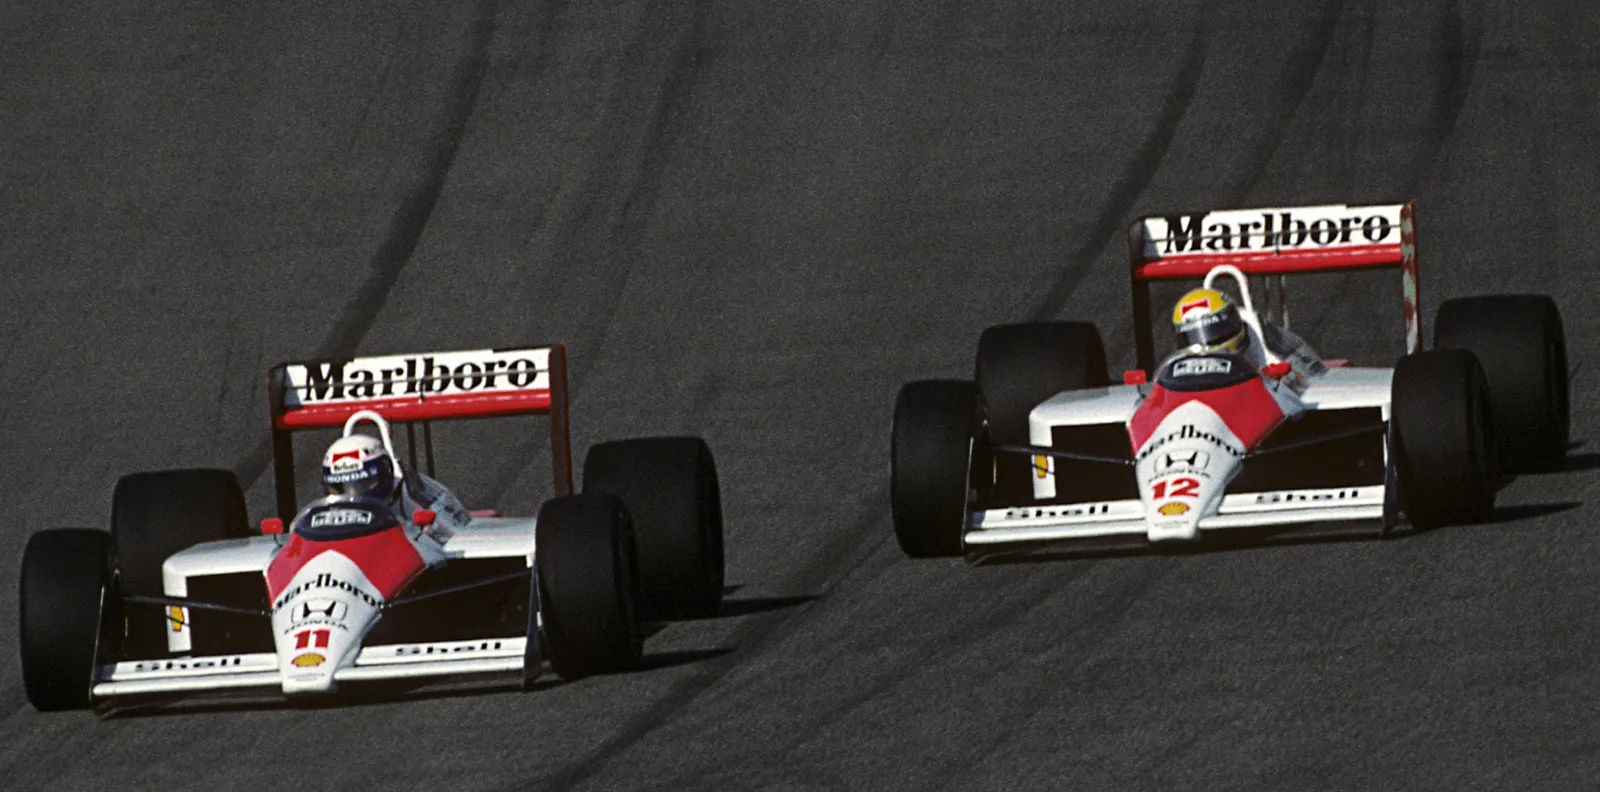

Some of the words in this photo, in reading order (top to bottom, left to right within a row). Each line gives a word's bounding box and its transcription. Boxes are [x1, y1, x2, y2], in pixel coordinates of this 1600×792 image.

[1164, 212, 1391, 253] Marlboro
[305, 357, 537, 401] Marlboro
[1137, 424, 1244, 463] Marlboro
[327, 471, 369, 484] HONDA
[1151, 477, 1200, 501] 12
[1255, 487, 1359, 504] Shell
[1004, 504, 1109, 520] Shell
[274, 573, 382, 612] Marlboro
[294, 628, 331, 651] 11
[394, 641, 502, 657] Shell
[134, 657, 241, 673] Shell
